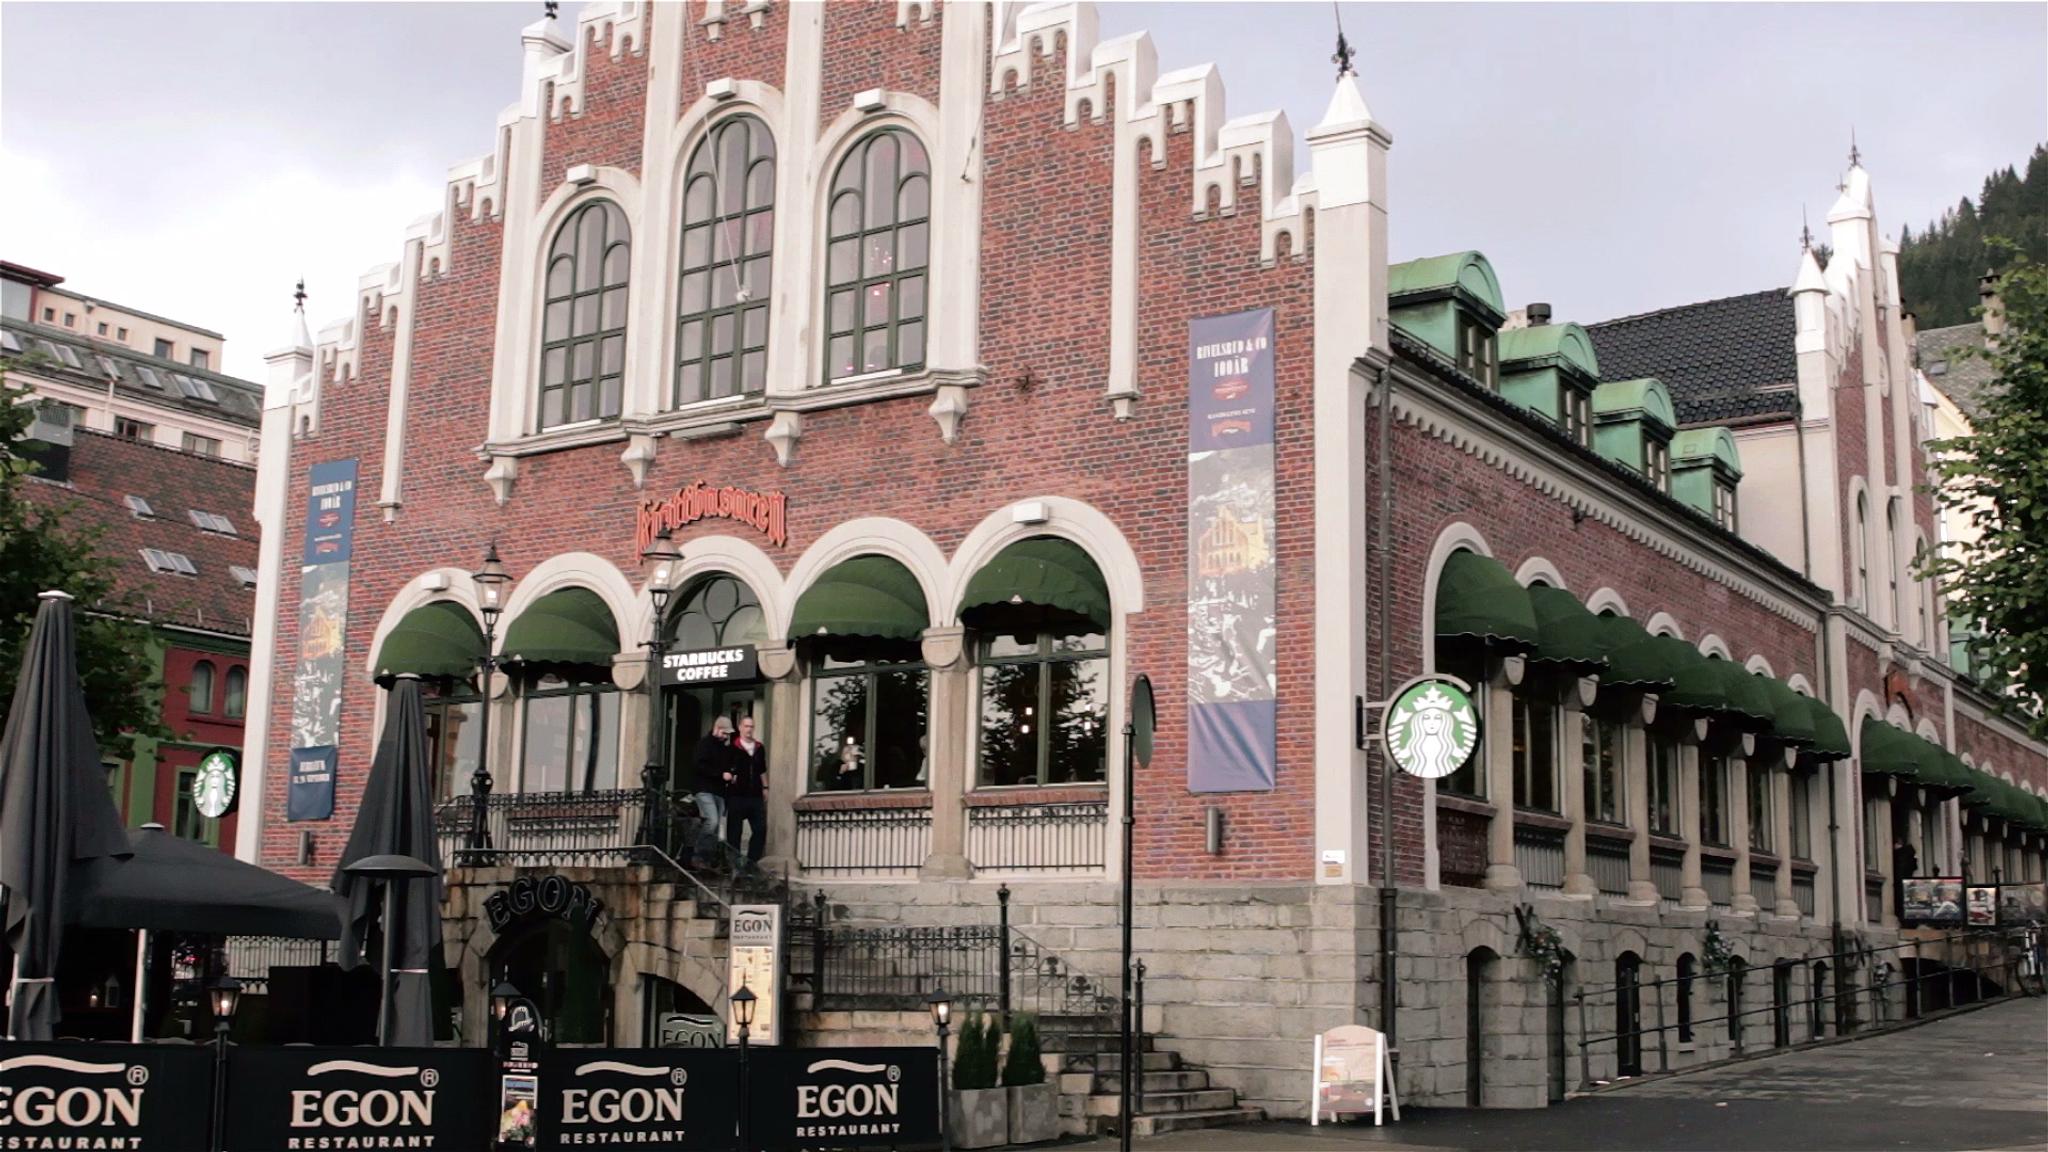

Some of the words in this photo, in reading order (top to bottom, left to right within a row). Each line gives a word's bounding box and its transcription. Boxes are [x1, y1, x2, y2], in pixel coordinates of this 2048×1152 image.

[663, 649, 744, 668] STARBUCKS
[677, 664, 728, 681] COFFEE
[482, 874, 604, 934] EGON
[734, 919, 773, 933] EGON
[661, 1030, 721, 1048] EGON
[290, 1089, 436, 1127] EGON
[561, 1087, 685, 1123] EGON
[796, 1083, 899, 1118] EGON
[560, 1131, 685, 1144] RESTAURANT
[796, 1123, 900, 1137] RESTAURANT
[0, 1136, 142, 1149] STAURANT
[288, 1135, 435, 1149] RESTAURANT
